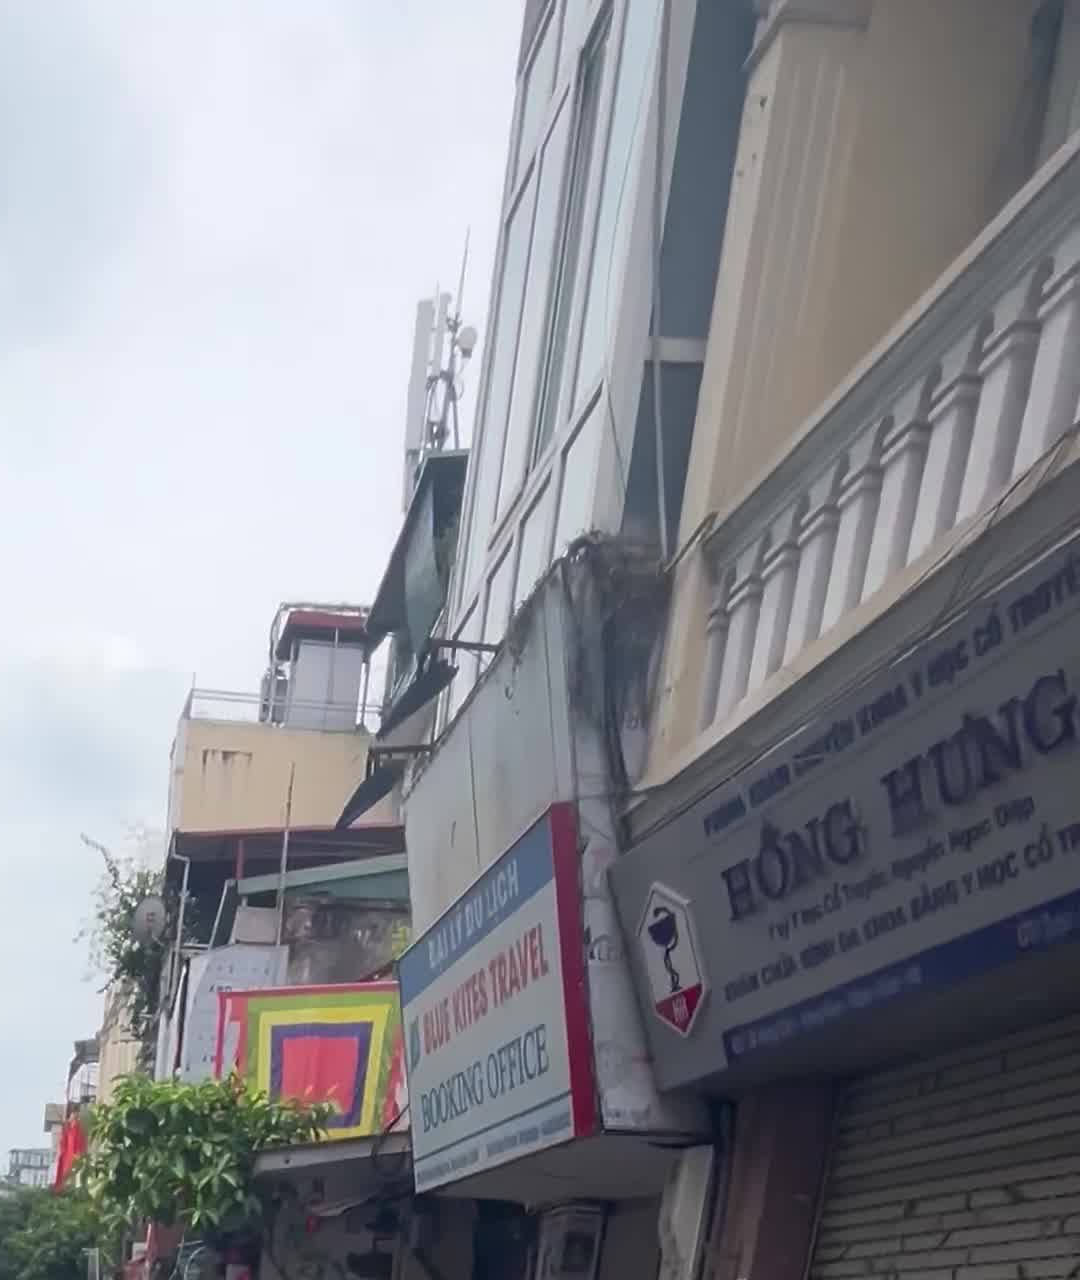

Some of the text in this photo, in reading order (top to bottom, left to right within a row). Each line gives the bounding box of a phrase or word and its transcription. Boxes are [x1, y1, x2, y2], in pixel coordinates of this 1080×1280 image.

[423, 922, 548, 1056] BLUE KITES TRAVEL
[421, 1023, 549, 1133] BOOKING OFFICE
